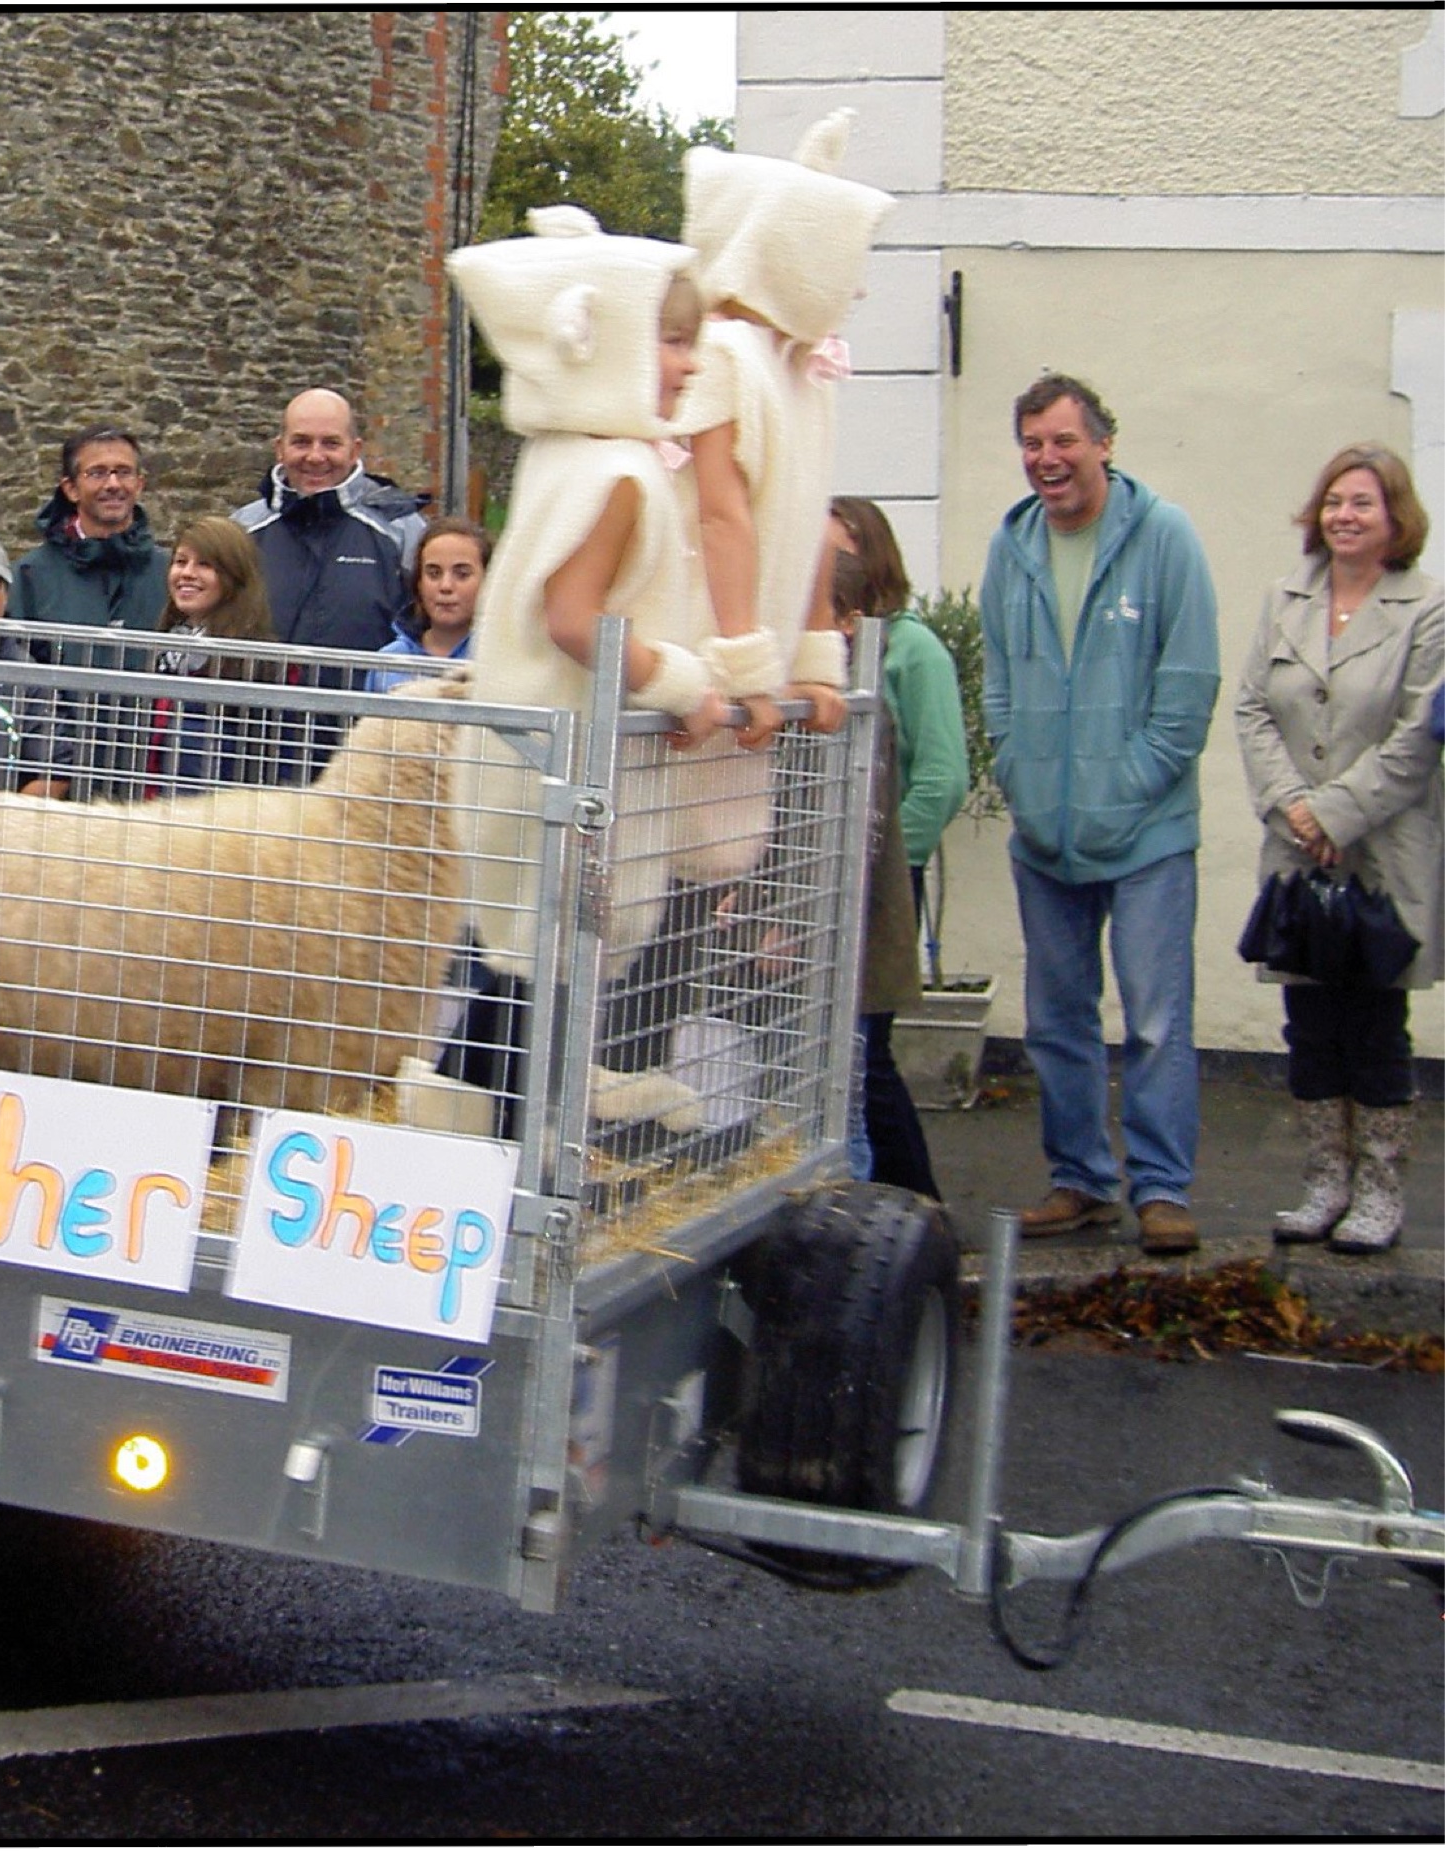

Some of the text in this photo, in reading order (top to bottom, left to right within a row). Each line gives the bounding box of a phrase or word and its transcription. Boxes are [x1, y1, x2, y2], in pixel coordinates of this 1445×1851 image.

[267, 1131, 496, 1324] Sheep
[119, 1328, 260, 1365] ENGINEERING
[409, 1377, 474, 1401] Williams
[386, 1401, 465, 1425] Trailers
